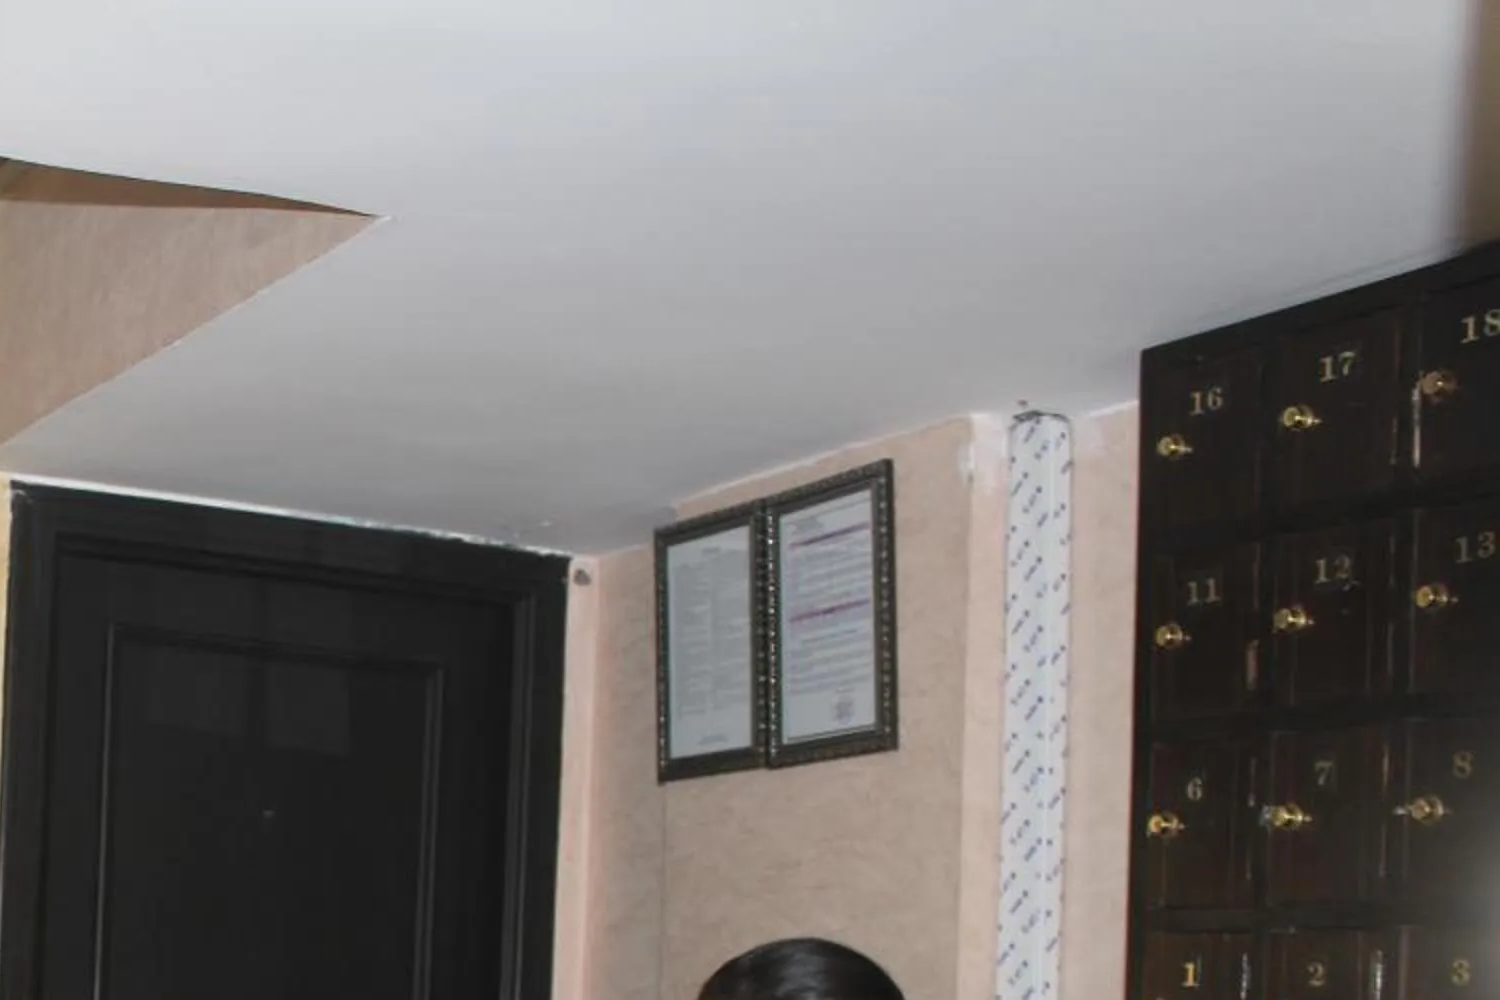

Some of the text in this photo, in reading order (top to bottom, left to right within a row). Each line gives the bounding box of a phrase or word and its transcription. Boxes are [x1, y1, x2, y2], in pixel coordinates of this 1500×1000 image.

[1459, 308, 1500, 344] 18
[1319, 350, 1357, 384] 17
[1189, 386, 1225, 417] 16
[1455, 530, 1496, 564] 13
[1314, 553, 1351, 585] 12
[1187, 576, 1221, 605] 11
[1315, 760, 1335, 786] 7
[1453, 750, 1475, 780] 8
[1186, 777, 1204, 801] 6
[1182, 962, 1200, 988] 1
[1307, 962, 1327, 988] 2
[1452, 958, 1473, 987] 3
